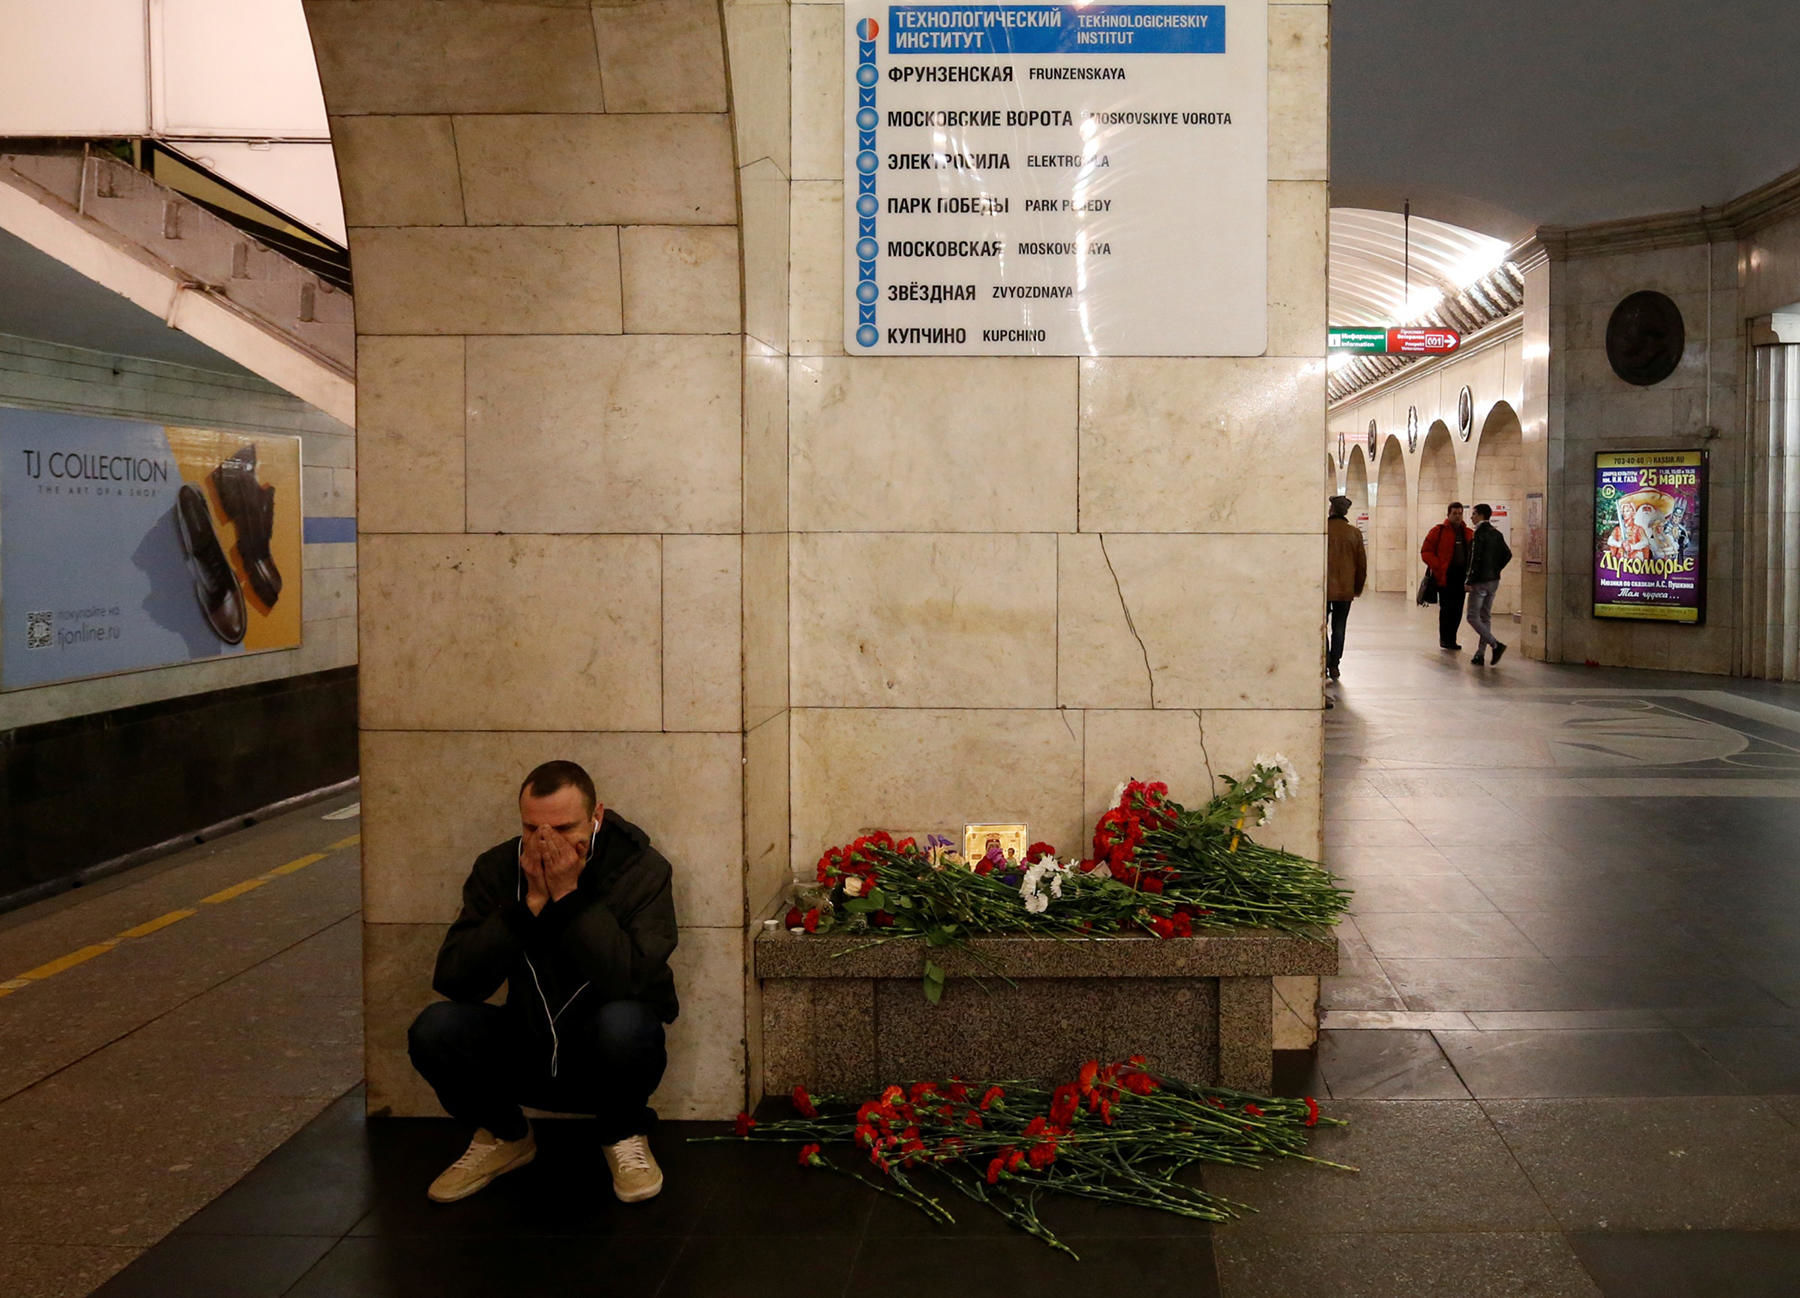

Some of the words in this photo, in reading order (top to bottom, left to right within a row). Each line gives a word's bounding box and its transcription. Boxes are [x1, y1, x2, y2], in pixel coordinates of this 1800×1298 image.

[896, 9, 1062, 29] ТЕХНОЛОГИЧЕСКИЙ
[1079, 15, 1208, 29] TEKHNOLOGICHESKIY
[896, 32, 984, 49] ИНСТИТУТ
[1077, 32, 1134, 44] INSTITUT
[888, 66, 1014, 83] ФРУНЗЕНСКАЯ
[1029, 68, 1126, 81] FRUNZENSKAYA
[888, 110, 1001, 127] МОСКОВСКИЕ
[1007, 110, 1073, 127] ВОРОТА
[1182, 112, 1232, 125] VOROTA
[1027, 154, 1110, 167] ELEKTROLA
[888, 197, 932, 213] ПАРК
[937, 197, 1009, 216] ПОБЕДЫ
[1025, 199, 1058, 211] PARK
[888, 241, 1002, 257] МОСКОВСКАЯ
[1018, 242, 1111, 255] MOSKOVSAYA
[888, 281, 976, 303] ЗВЁЗДНАЯ
[992, 286, 1074, 299] ZVYOZDNAYA
[888, 327, 966, 344] КУПЧИНО
[983, 330, 1046, 342] KUPCHINO
[23, 450, 41, 479] TJ
[49, 452, 168, 482] COLLECTION
[1639, 469, 1657, 487] 25
[1659, 474, 1696, 488] марта
[1600, 550, 1695, 579] Лукоморье
